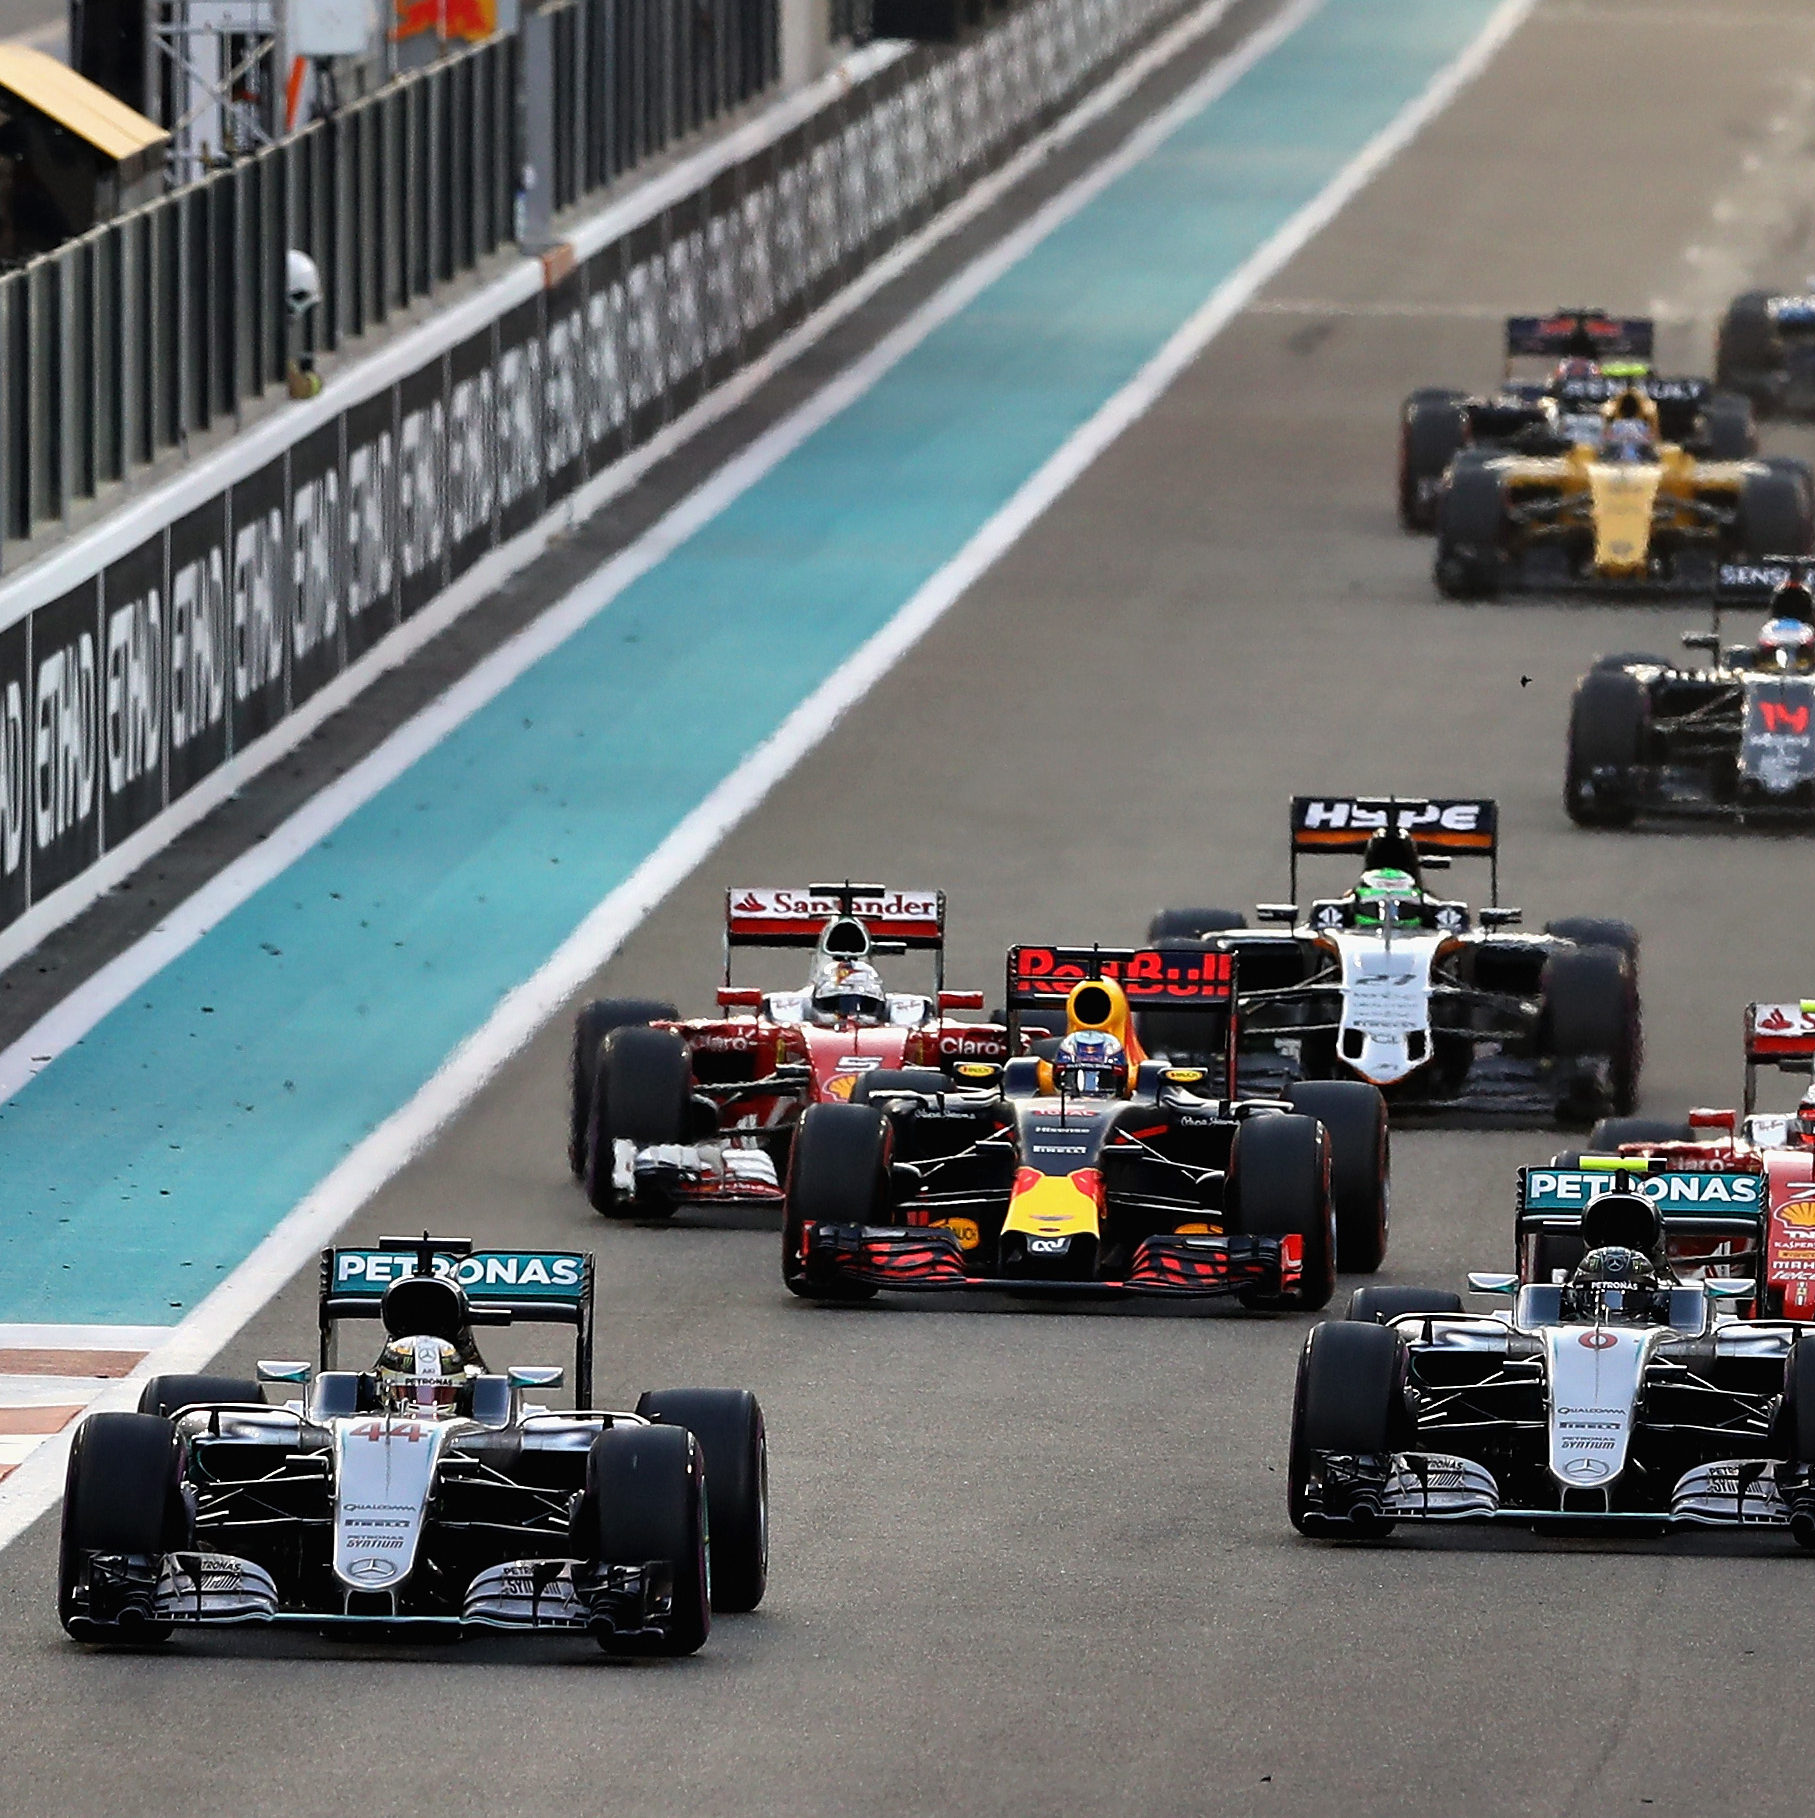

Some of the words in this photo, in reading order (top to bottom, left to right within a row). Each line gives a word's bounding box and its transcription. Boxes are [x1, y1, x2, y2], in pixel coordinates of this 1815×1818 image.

[1758, 701, 1810, 734] 14
[1304, 801, 1480, 830] HYPE
[773, 892, 935, 916] Sanander
[1125, 952, 1233, 997] Bull
[940, 1036, 999, 1055] Claro
[833, 1056, 884, 1073] 5
[1530, 1172, 1757, 1203] PETONAS
[1591, 1281, 1638, 1291] PETRONAS
[349, 1422, 429, 1443] 44
